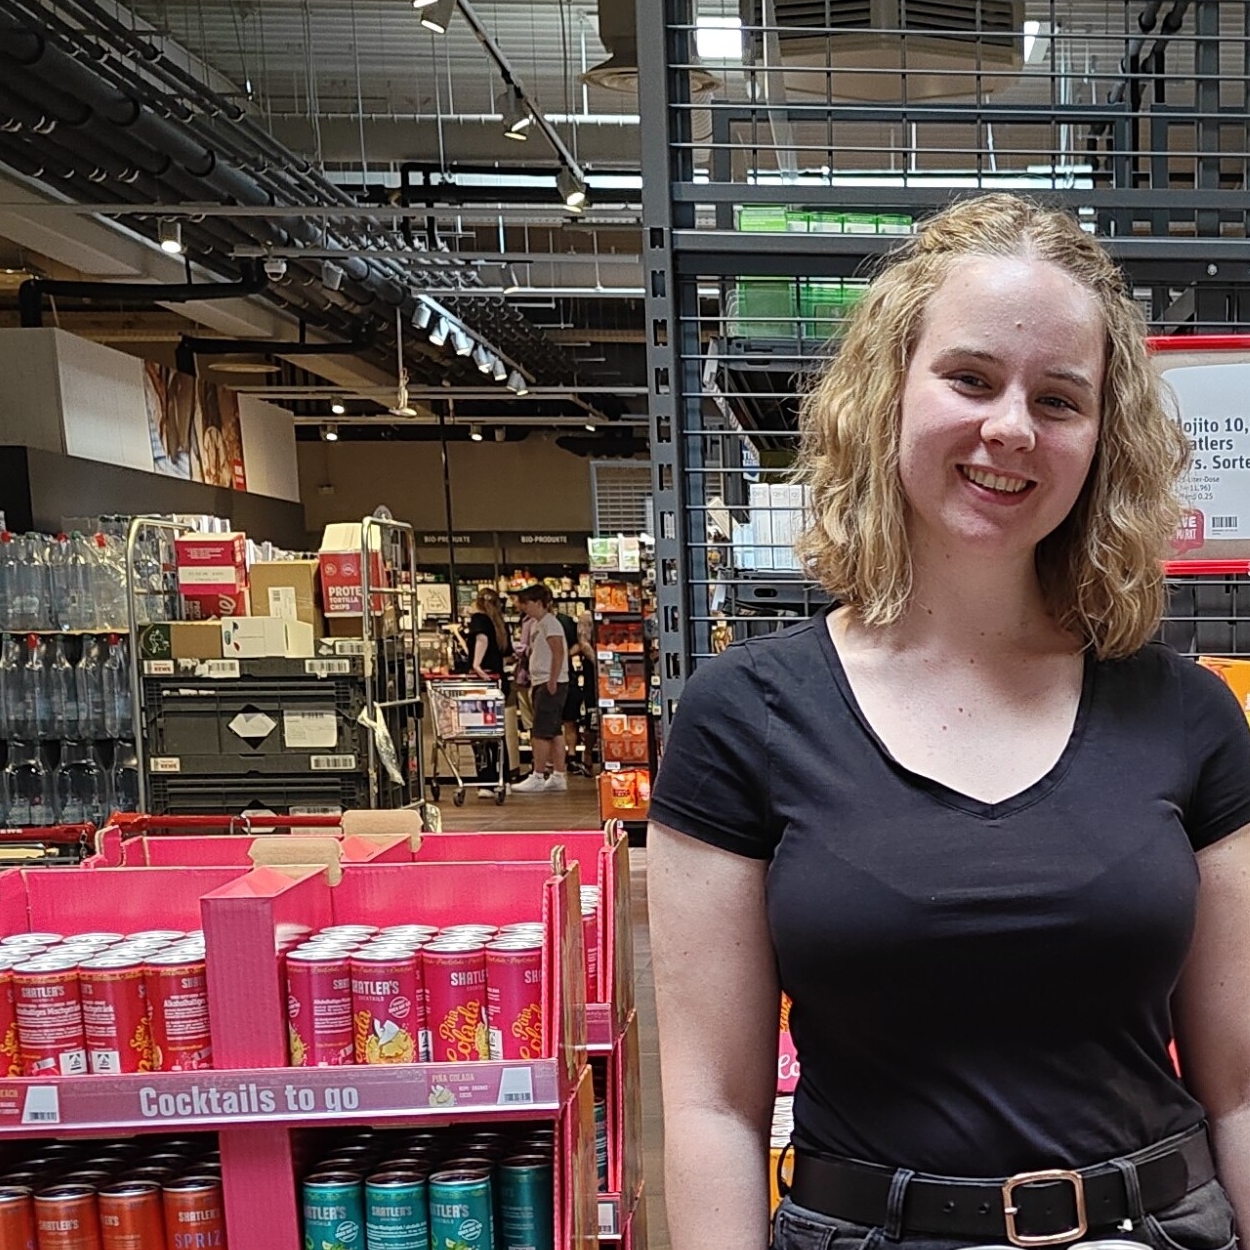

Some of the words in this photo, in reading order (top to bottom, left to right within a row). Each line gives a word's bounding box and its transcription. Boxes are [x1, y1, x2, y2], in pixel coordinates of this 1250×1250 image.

[1178, 417, 1219, 436] ojito
[1187, 436, 1234, 451] atlers
[423, 535, 471, 543] BIO-PRDUKTE
[327, 586, 363, 598] PROTE
[450, 969, 486, 986] SHATLE
[351, 979, 399, 995] HATLER'S
[139, 1083, 276, 1117] Cocktails
[284, 1084, 315, 1111] to
[324, 1086, 360, 1112] go
[175, 1230, 222, 1250] SPRIZ
